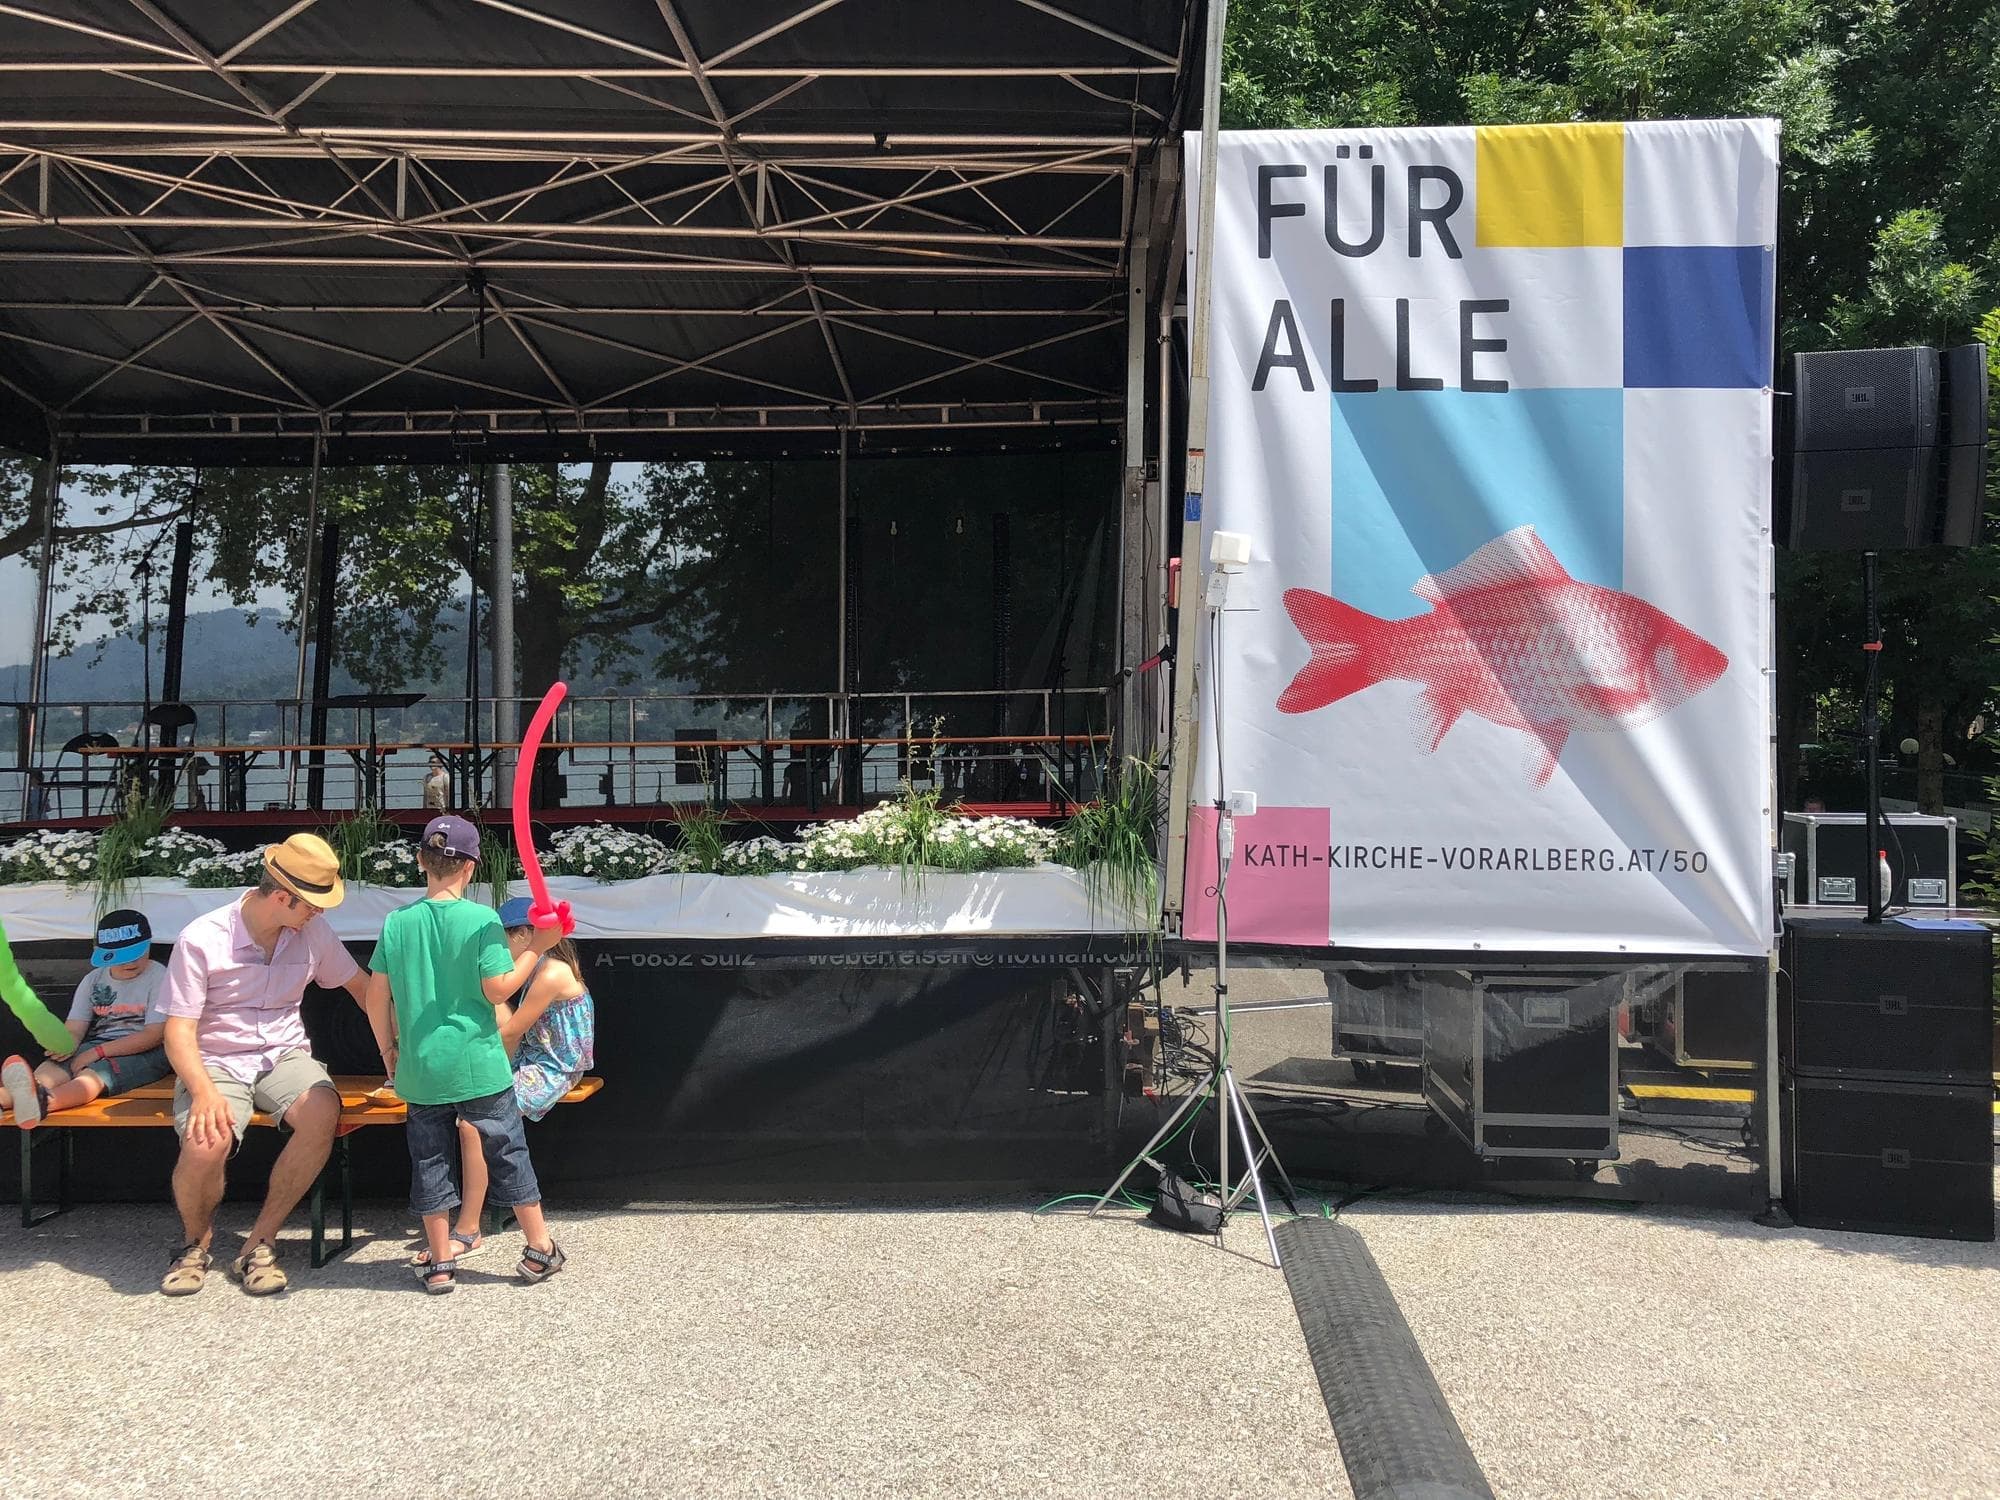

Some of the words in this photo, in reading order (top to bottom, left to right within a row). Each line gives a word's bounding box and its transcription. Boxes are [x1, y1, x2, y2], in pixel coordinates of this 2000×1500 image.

[1257, 145, 1465, 259] FÜR
[1252, 298, 1510, 393] ALLE
[1244, 844, 1709, 873] KATH-KIRCHE-VORARLBERG.AT/50
